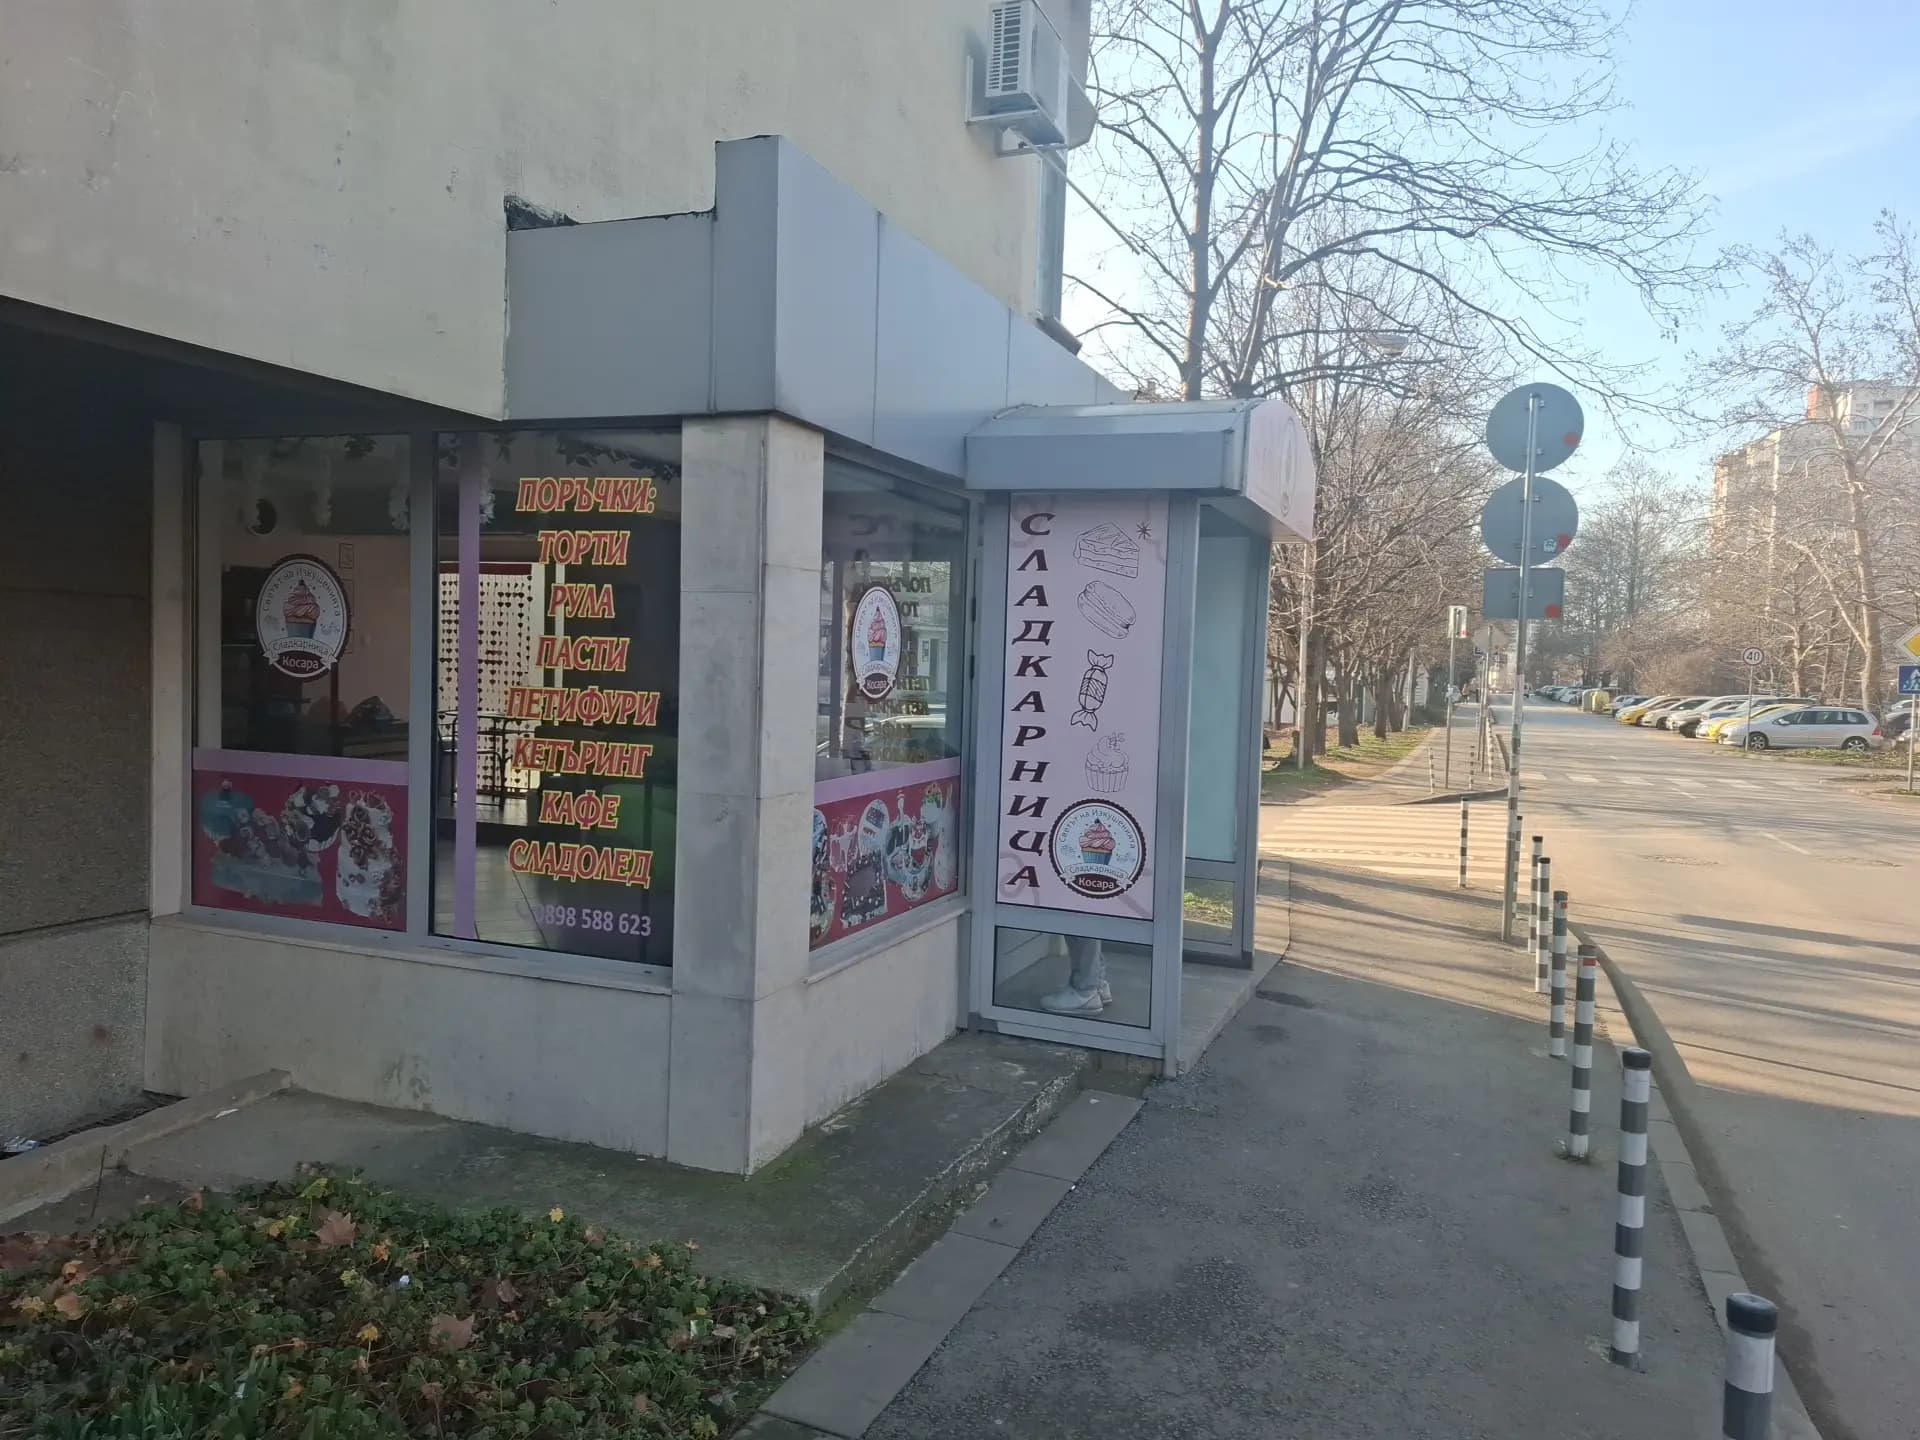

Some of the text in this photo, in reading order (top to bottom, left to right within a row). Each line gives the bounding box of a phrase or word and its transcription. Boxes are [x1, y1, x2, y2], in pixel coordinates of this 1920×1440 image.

[515, 477, 657, 513] ПОРЪЧКИ:
[537, 530, 631, 566] ТОРТИ
[547, 583, 616, 618] РУЛА
[282, 655, 319, 671] Косара
[535, 635, 631, 672] ПАСТИ
[1746, 651, 1761, 661] 40
[505, 686, 661, 727] ПЕТИФУРИ
[1005, 512, 1056, 888] СЛАДКАРНИЦА
[511, 737, 654, 778] КЕТЪРИНГ
[538, 790, 621, 830] КАФЕ
[507, 838, 654, 889] СЛАДОЛЕД
[1069, 865, 1124, 879] Сладкарница
[1078, 877, 1115, 890] Косара
[533, 904, 652, 936] 0898 588 623
